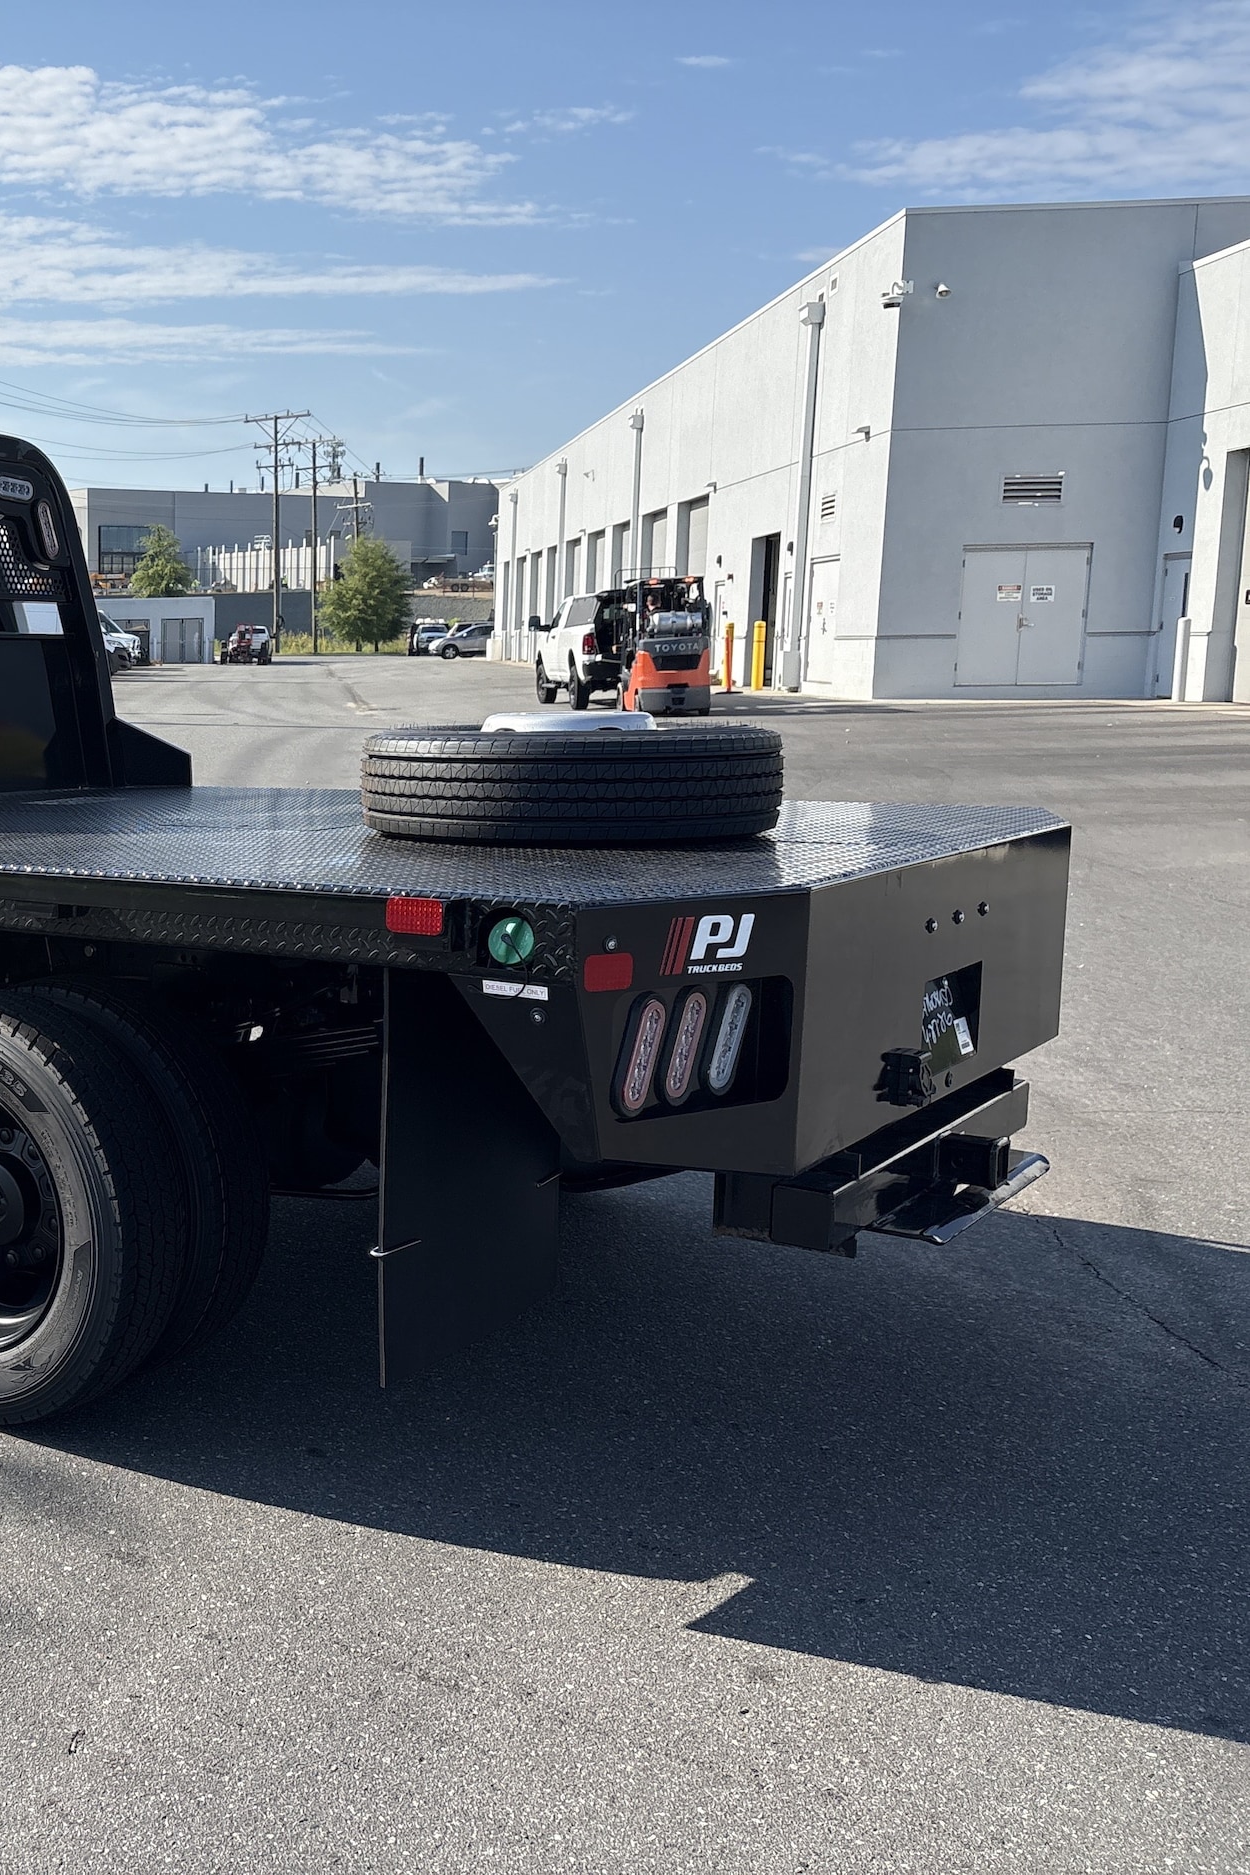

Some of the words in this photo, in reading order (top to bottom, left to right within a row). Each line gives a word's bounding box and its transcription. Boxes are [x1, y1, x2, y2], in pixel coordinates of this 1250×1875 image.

[654, 642, 699, 653] TOYOTA
[689, 913, 756, 960] PJ
[485, 983, 508, 992] DIESEL
[507, 986, 526, 995] FUE
[526, 988, 546, 997] ONLY
